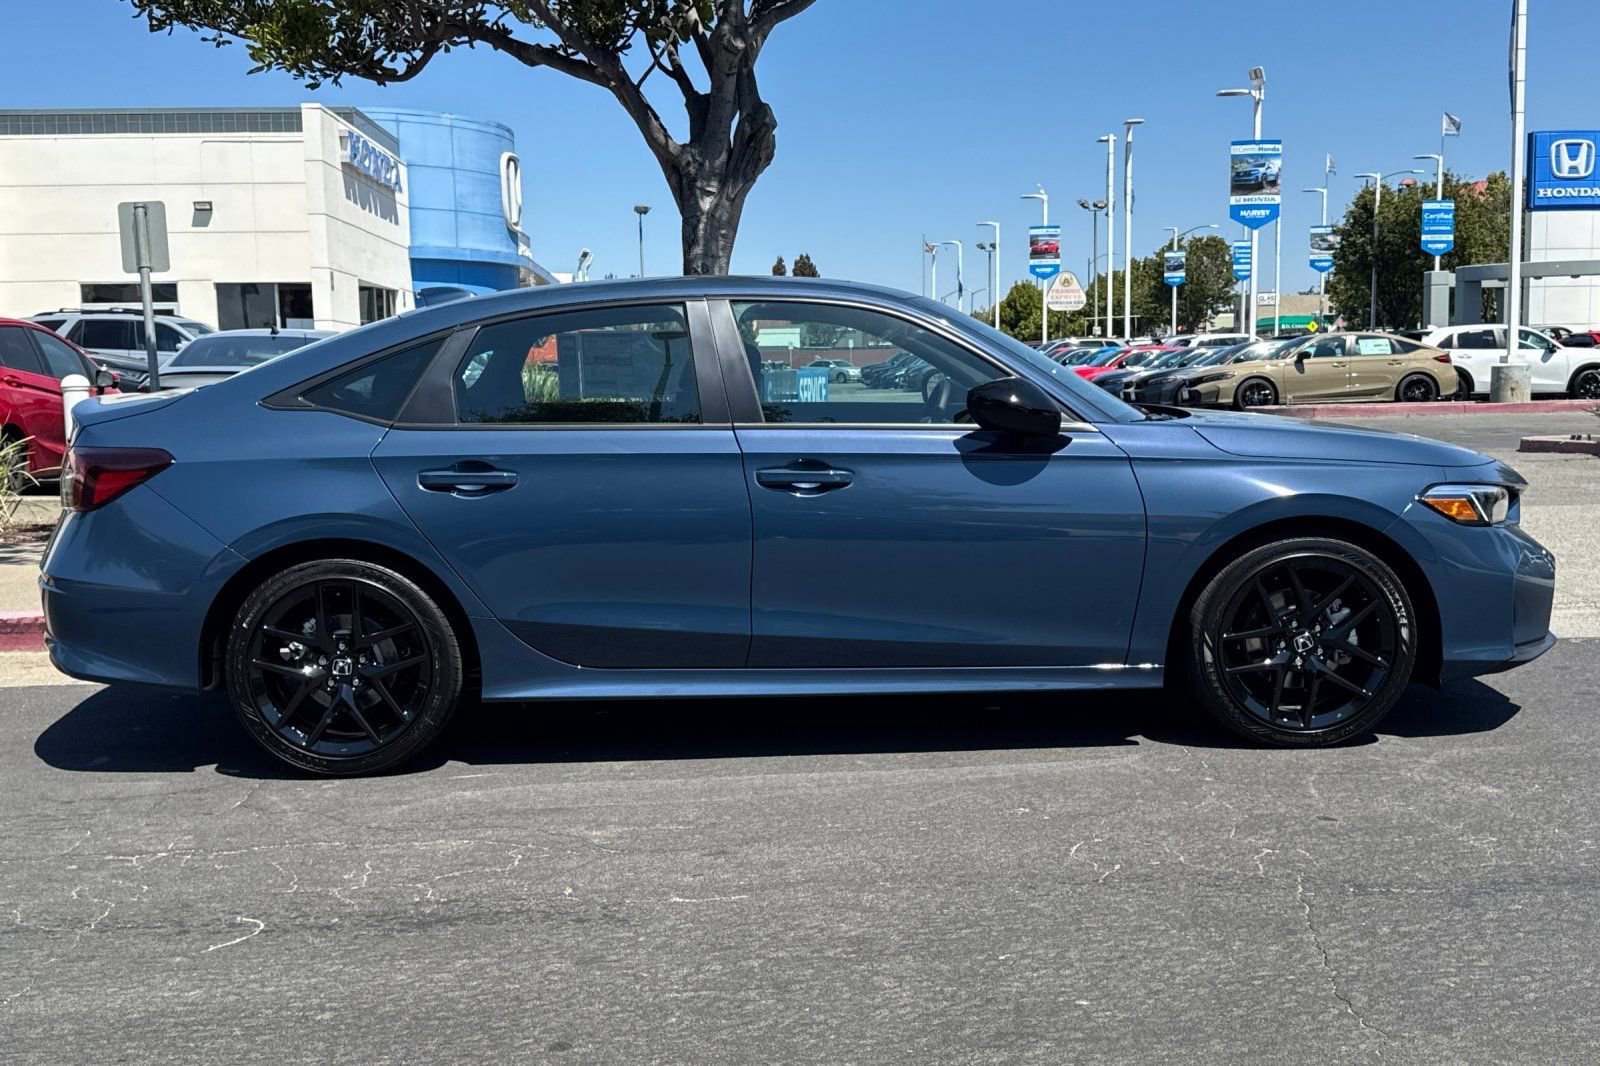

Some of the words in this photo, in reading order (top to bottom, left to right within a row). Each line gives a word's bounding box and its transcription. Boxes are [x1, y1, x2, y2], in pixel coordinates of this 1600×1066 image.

[348, 130, 403, 193] HONDA
[1537, 187, 1600, 198] HONDA
[1240, 209, 1270, 217] HARVEY
[799, 376, 827, 402] SERVICE
